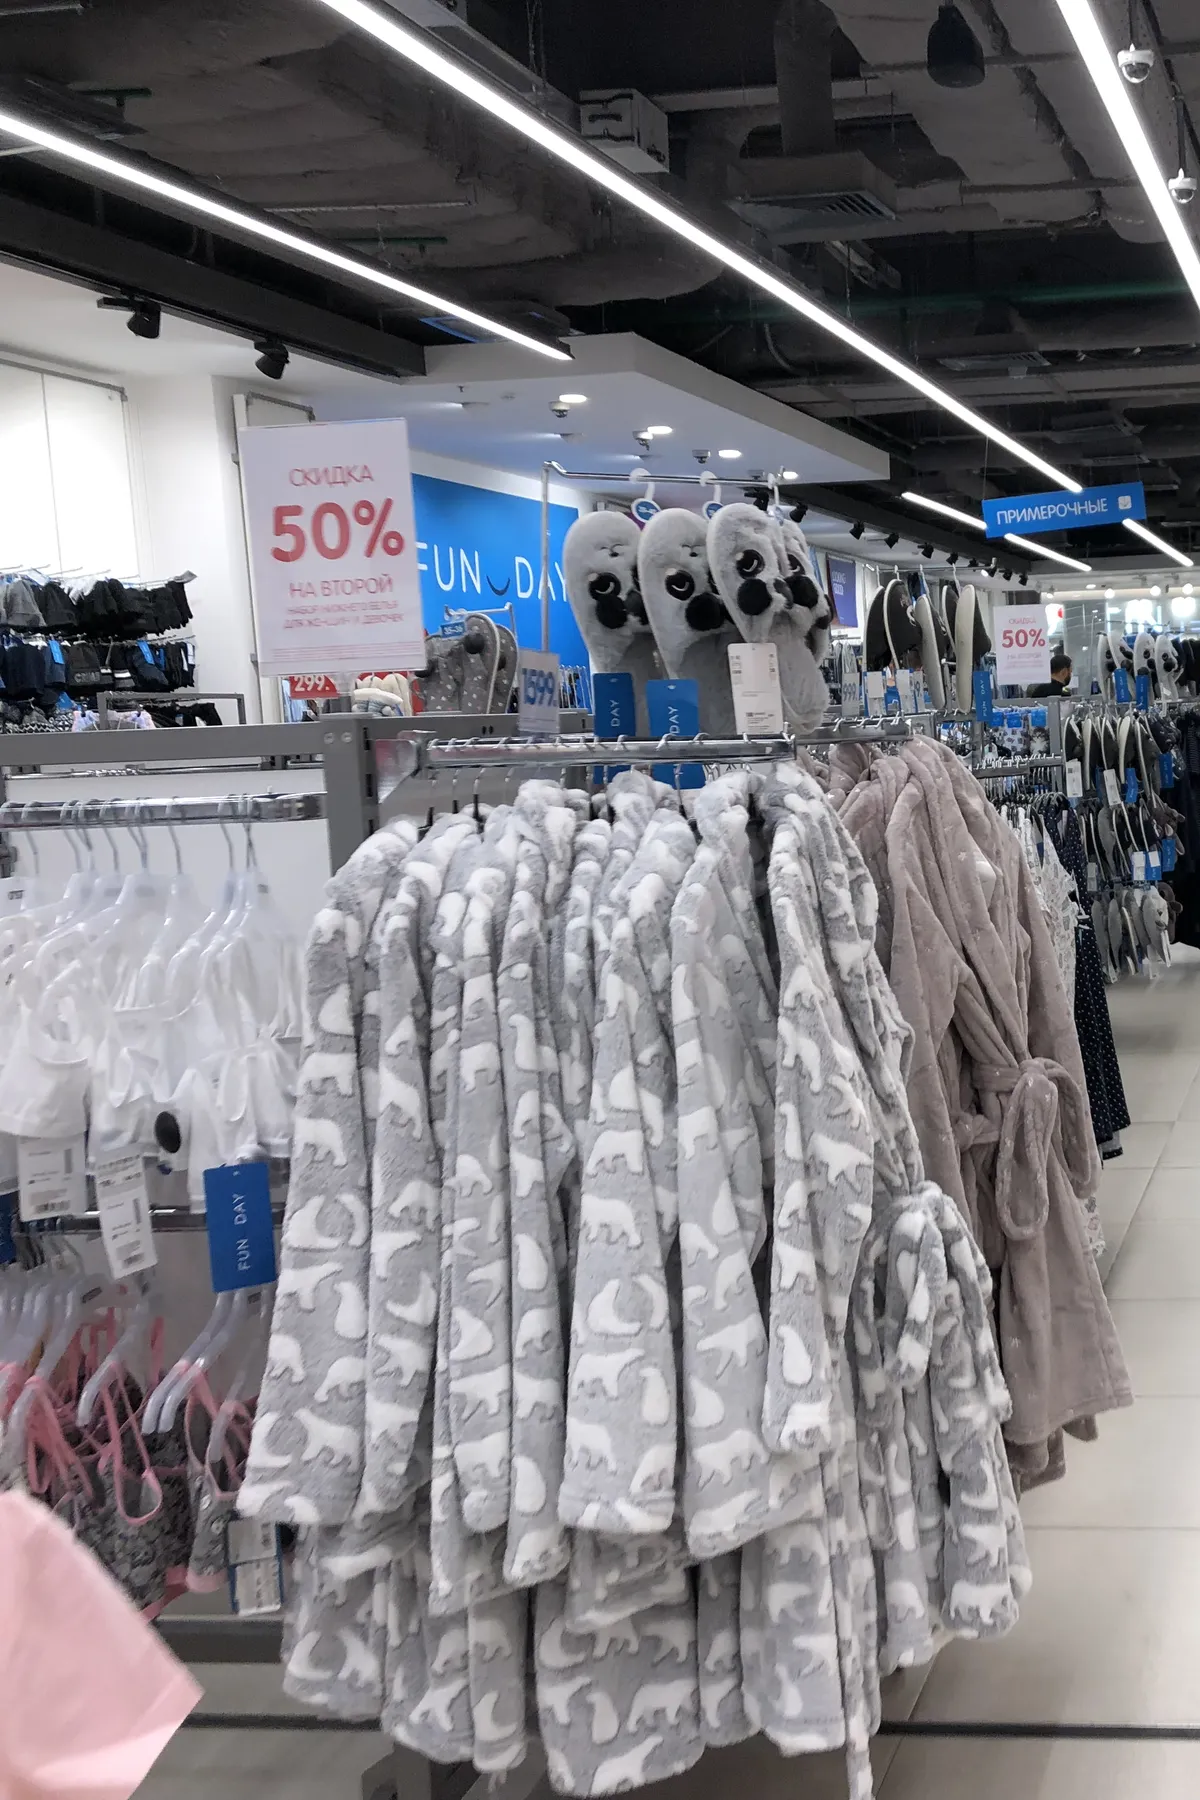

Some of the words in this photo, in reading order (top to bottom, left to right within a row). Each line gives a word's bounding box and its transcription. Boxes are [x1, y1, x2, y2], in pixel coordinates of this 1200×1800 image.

[288, 464, 374, 488] СКИДКА
[996, 497, 1108, 526] ПРИМЕРОЧНЫЕ
[271, 497, 405, 563] 50%
[288, 581, 318, 599] НА
[320, 573, 394, 597] ВТОРОЙ
[1001, 628, 1046, 649] 50%
[609, 699, 621, 728] DAY
[667, 705, 681, 735] DAY
[231, 1193, 249, 1226] DAY
[235, 1238, 252, 1271] FUN
